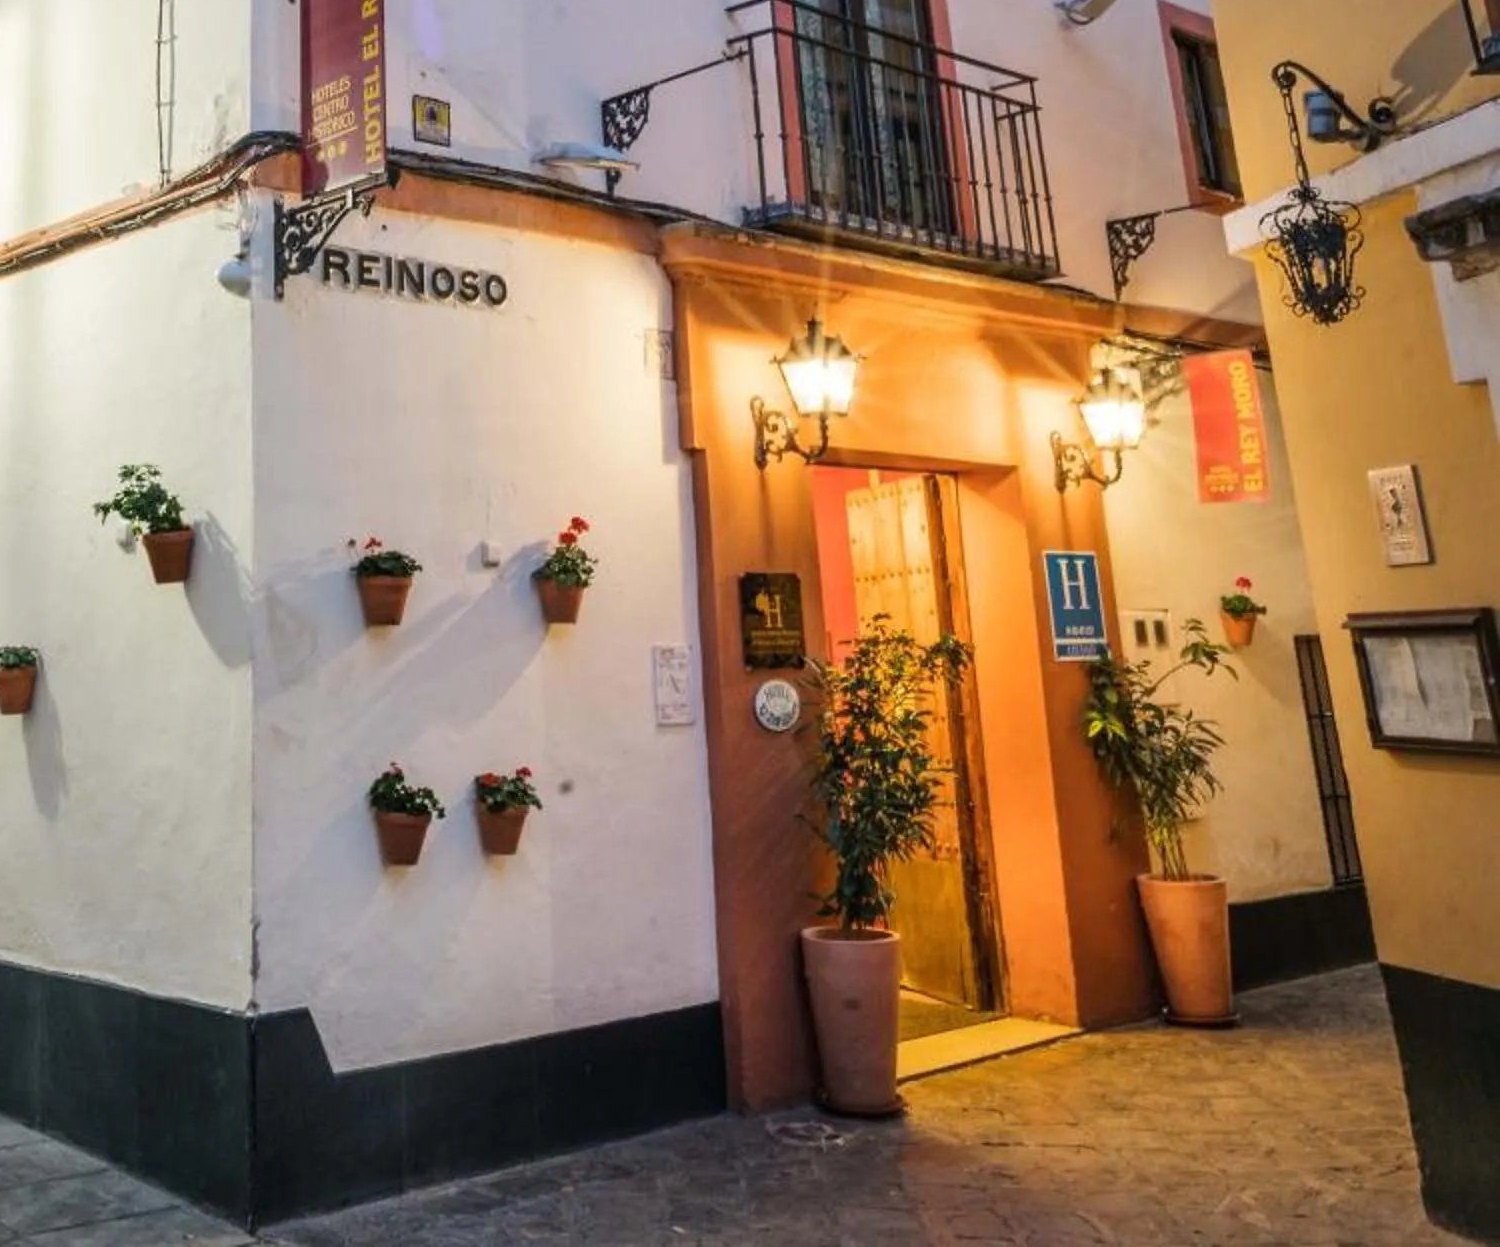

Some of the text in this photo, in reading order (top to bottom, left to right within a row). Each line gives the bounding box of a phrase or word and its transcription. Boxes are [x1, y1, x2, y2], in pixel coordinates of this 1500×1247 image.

[362, 23, 380, 61] EL
[363, 64, 382, 164] HOTEL
[323, 248, 507, 306] REINOSO
[1228, 361, 1263, 492] EL REY MORO
[1056, 558, 1091, 610] H
